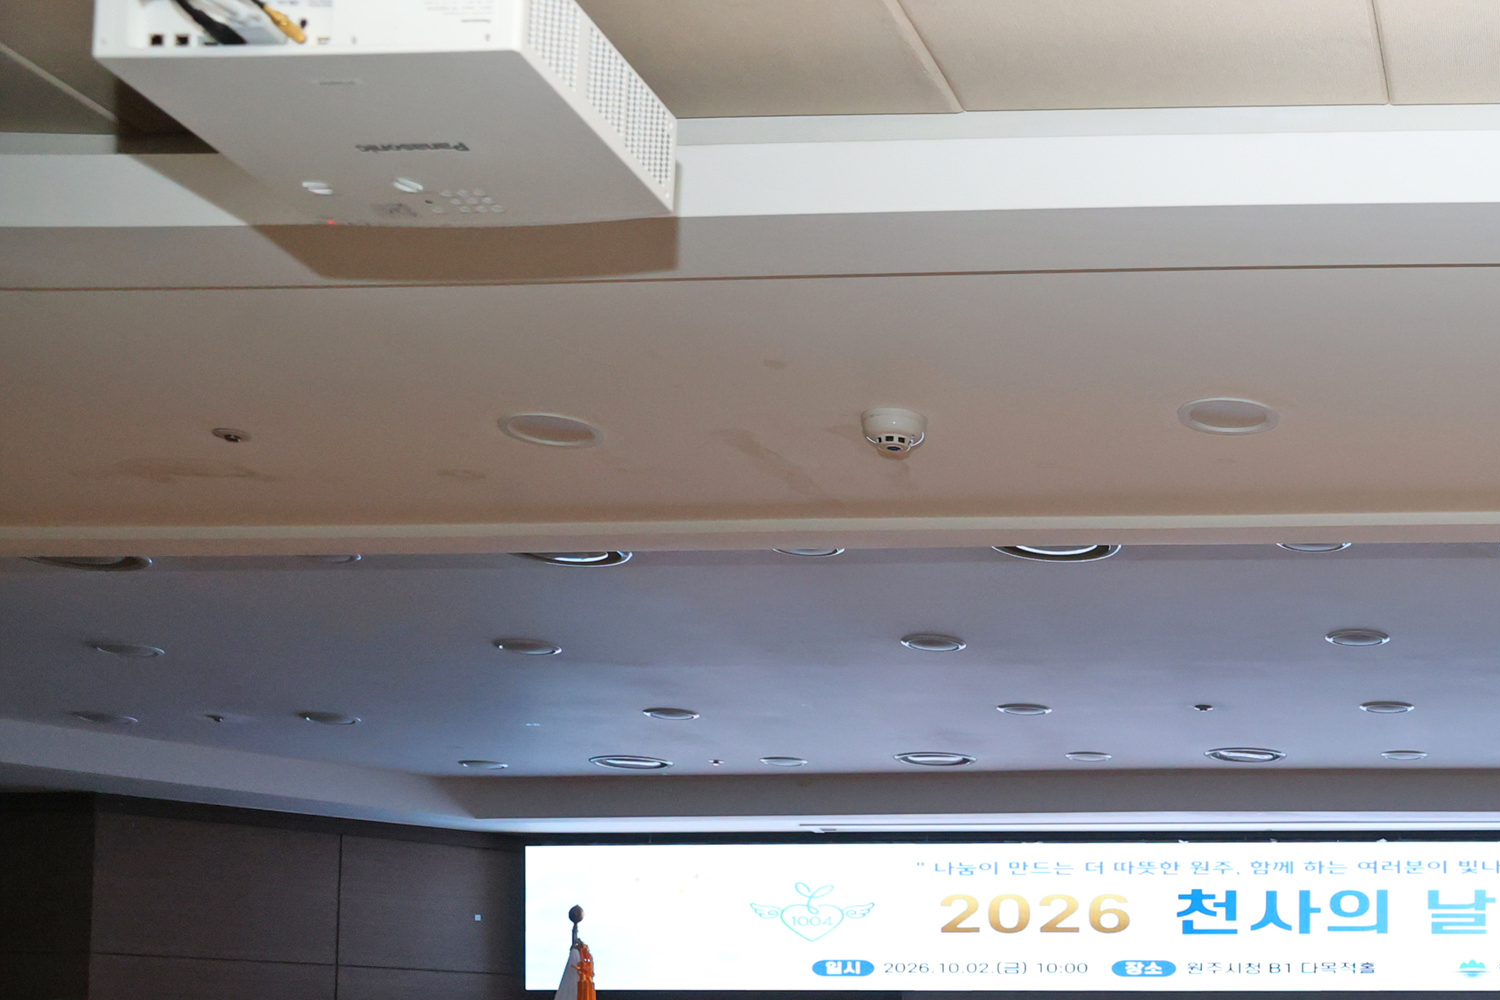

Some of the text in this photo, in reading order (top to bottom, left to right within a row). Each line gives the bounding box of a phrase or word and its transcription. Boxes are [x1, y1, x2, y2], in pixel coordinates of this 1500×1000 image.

[935, 861, 998, 876] 나눔이
[1009, 861, 1074, 876] 만드는
[1085, 861, 1104, 875] 더
[1114, 861, 1180, 875] 따뜻한
[1190, 861, 1240, 876] 원주,
[1250, 861, 1294, 875] 함께
[1303, 861, 1348, 875] 하는
[1357, 860, 1447, 875] 여러분이
[939, 893, 1131, 935] 2026
[1176, 888, 1389, 935] 천사의
[1428, 889, 1495, 935] 날
[792, 916, 833, 927] 1004
[825, 960, 861, 976] 일시
[1036, 962, 1088, 974] 10:00
[1125, 961, 1375, 976] 장소 원주시청 B1 다목적홀
